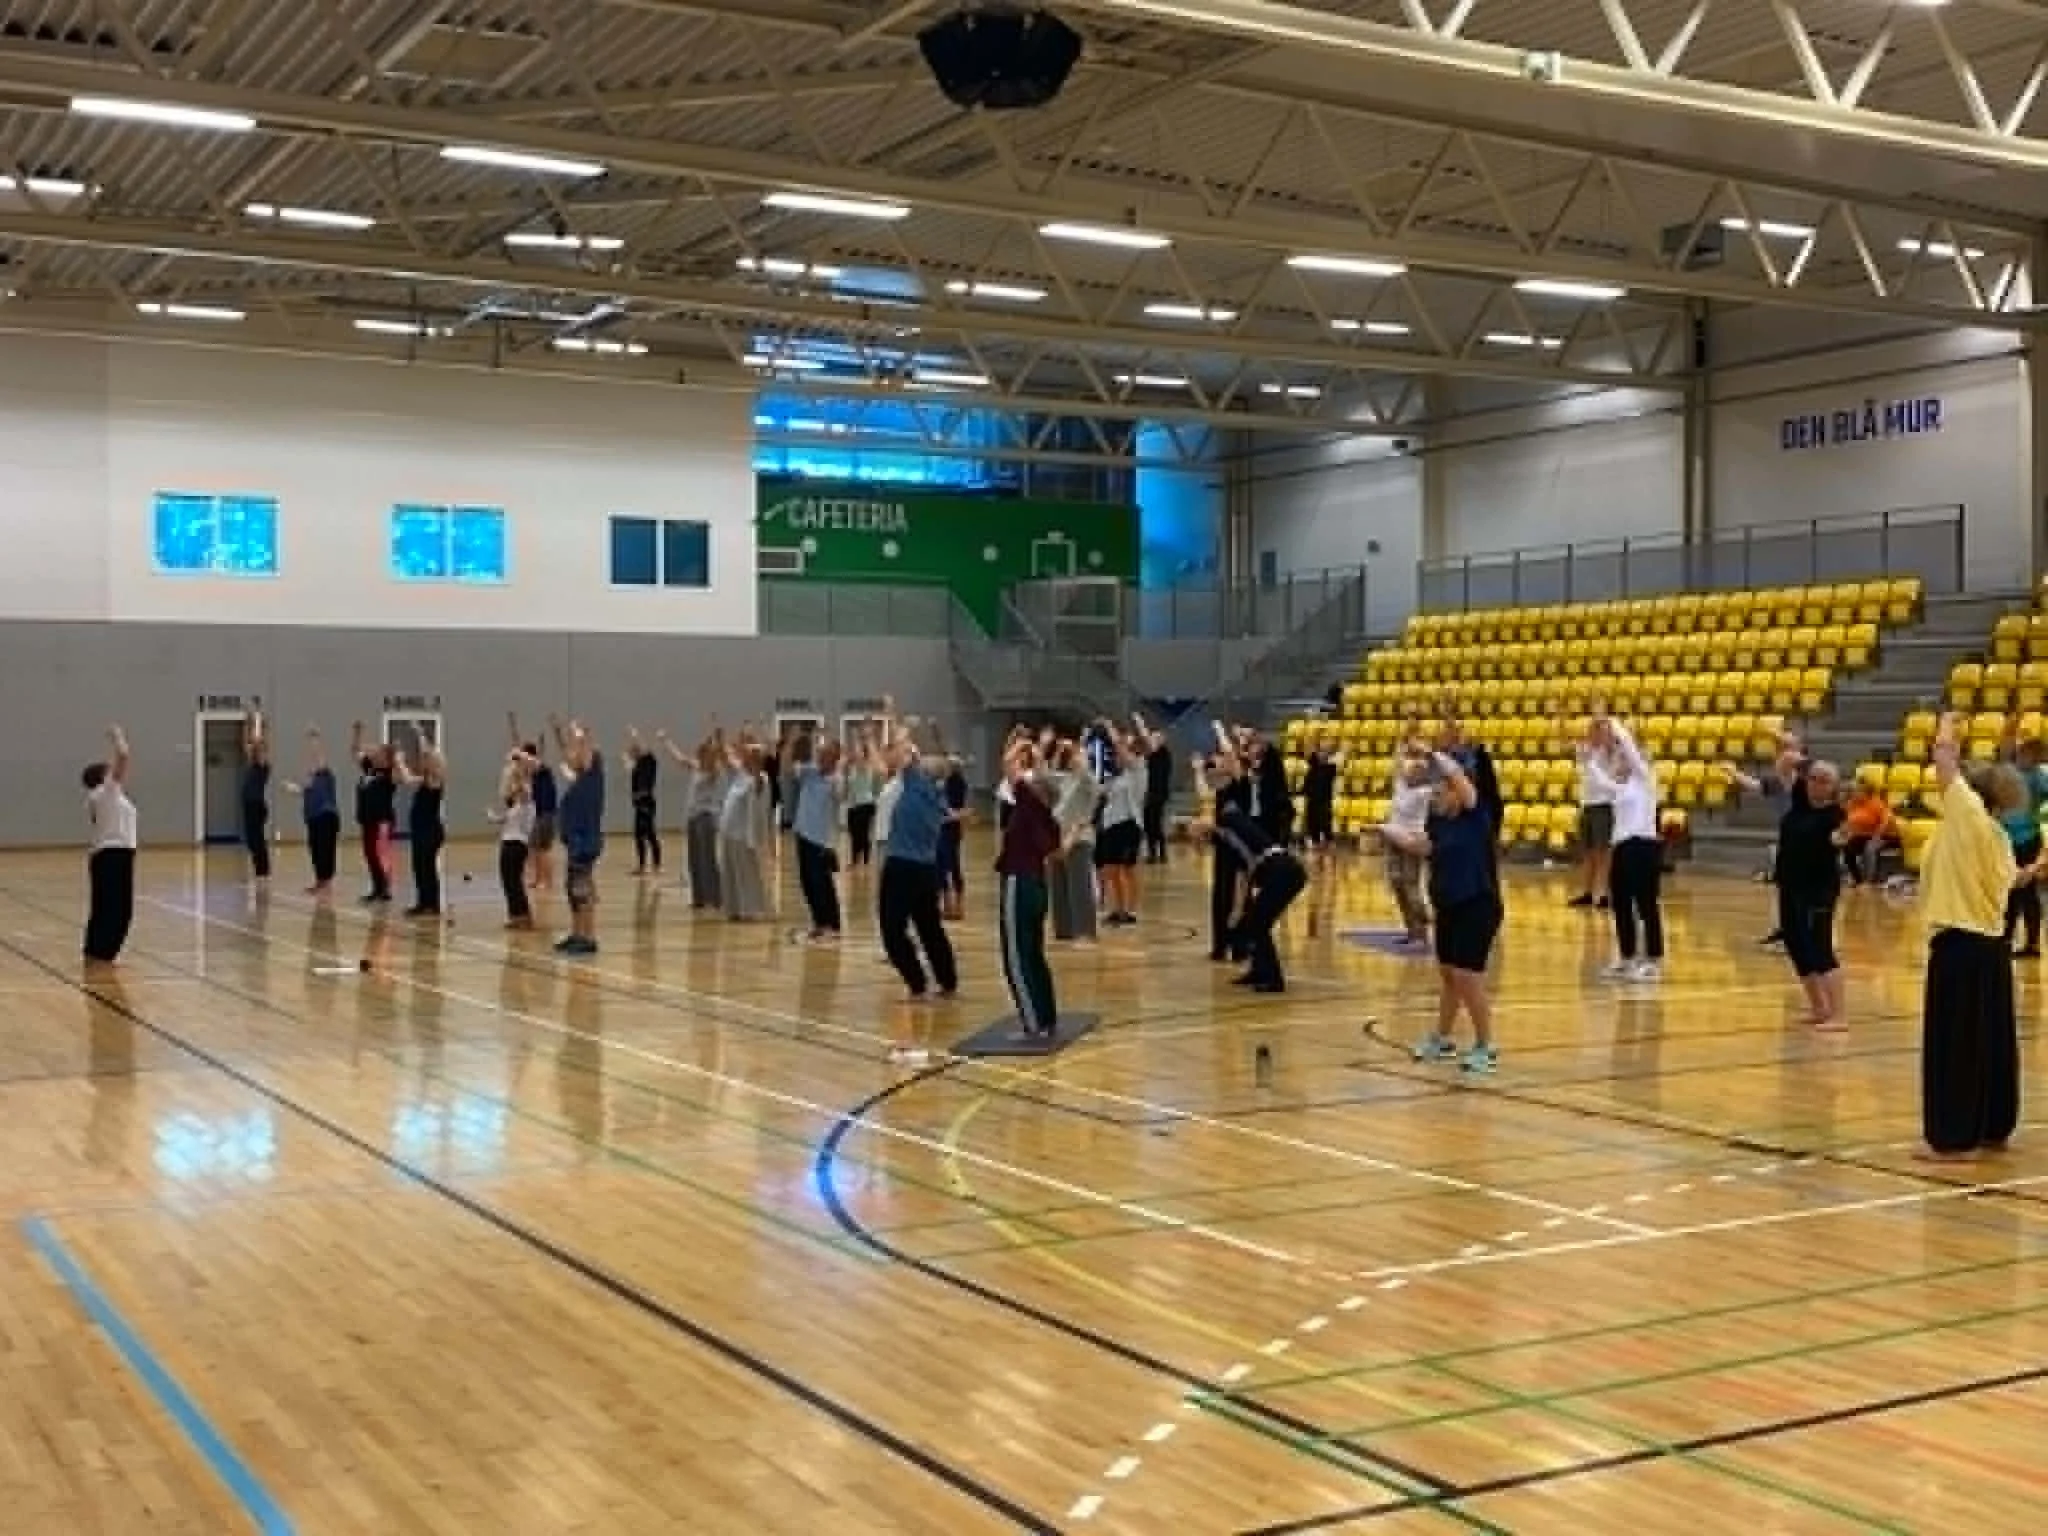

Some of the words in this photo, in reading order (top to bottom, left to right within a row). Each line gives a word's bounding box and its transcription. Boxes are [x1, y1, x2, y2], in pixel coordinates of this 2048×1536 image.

[1781, 415, 1825, 449] DEN
[1831, 399, 1876, 442] BLÅ
[1883, 399, 1943, 436] MUR
[787, 498, 909, 533] CAFETERIA
